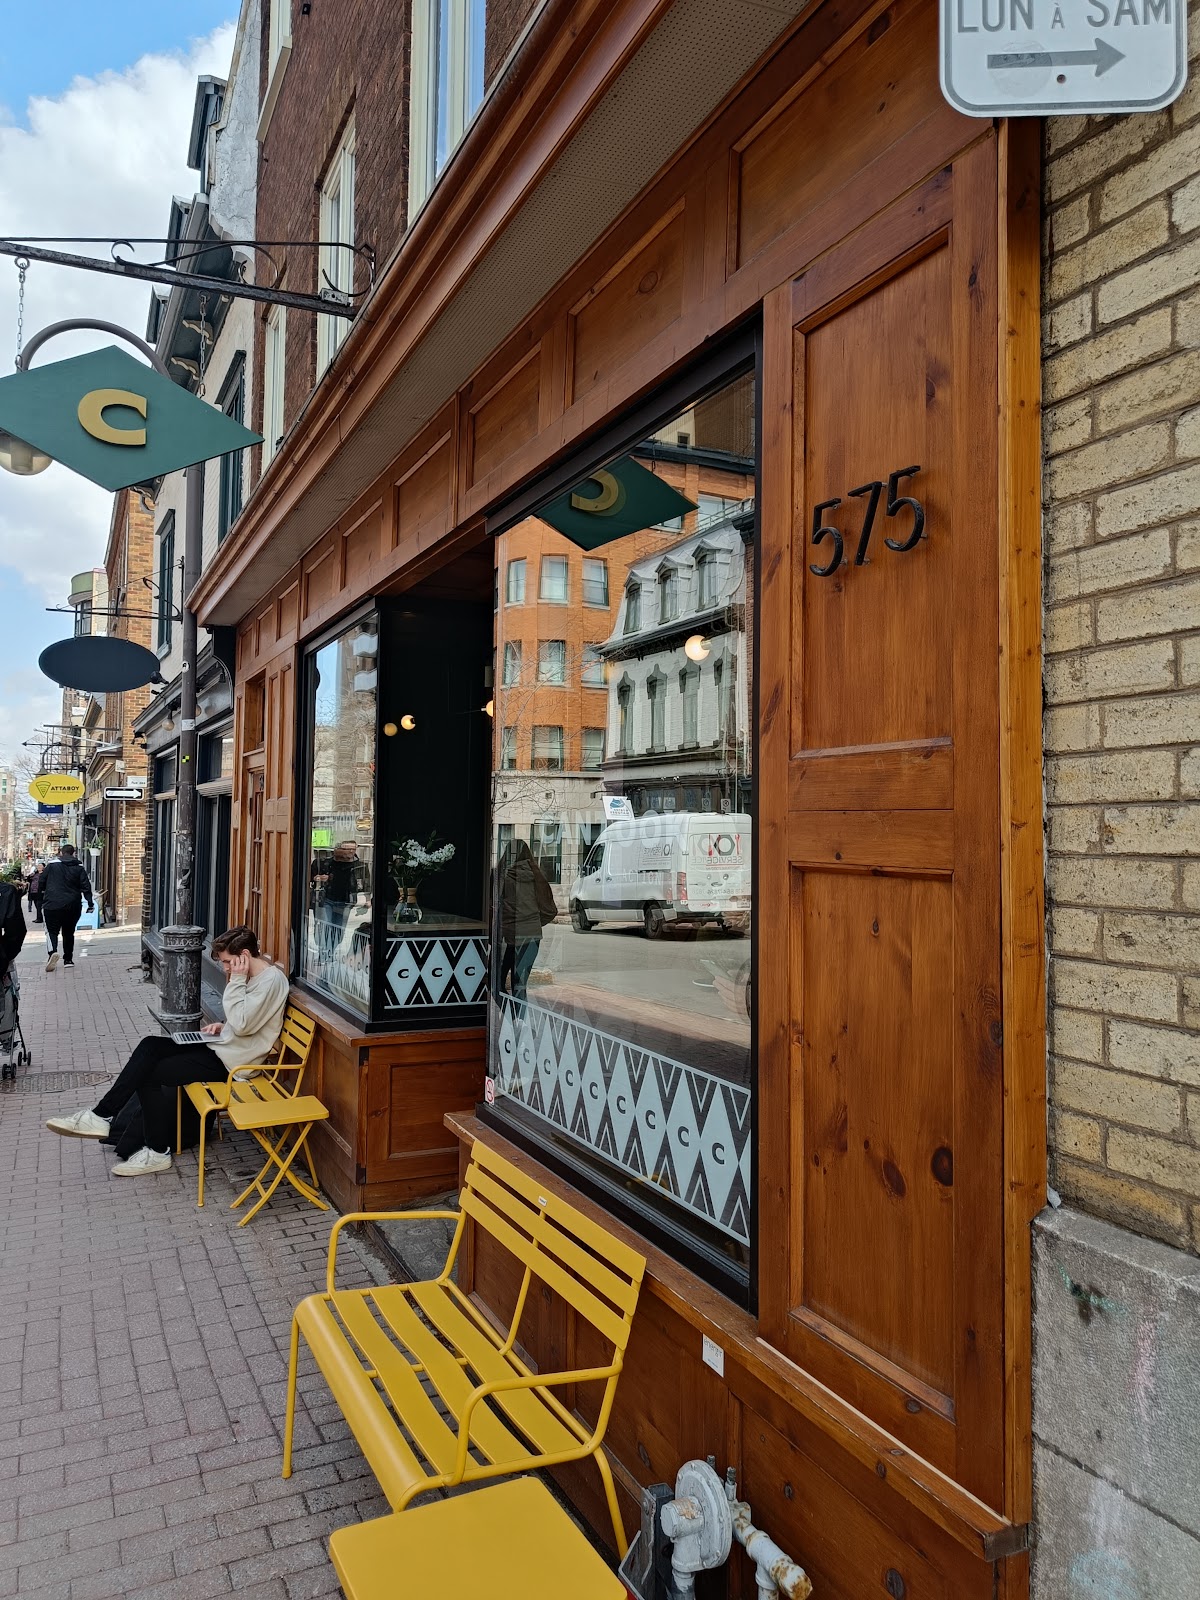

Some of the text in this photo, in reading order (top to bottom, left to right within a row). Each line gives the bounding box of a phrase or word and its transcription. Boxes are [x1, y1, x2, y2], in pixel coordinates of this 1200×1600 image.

[957, 0, 1034, 33] LUN
[1086, 0, 1172, 28] SAM
[77, 388, 147, 446] C
[809, 465, 925, 577] 575
[398, 967, 475, 979] C C C
[504, 1039, 724, 1164] C C C C C C C C C
